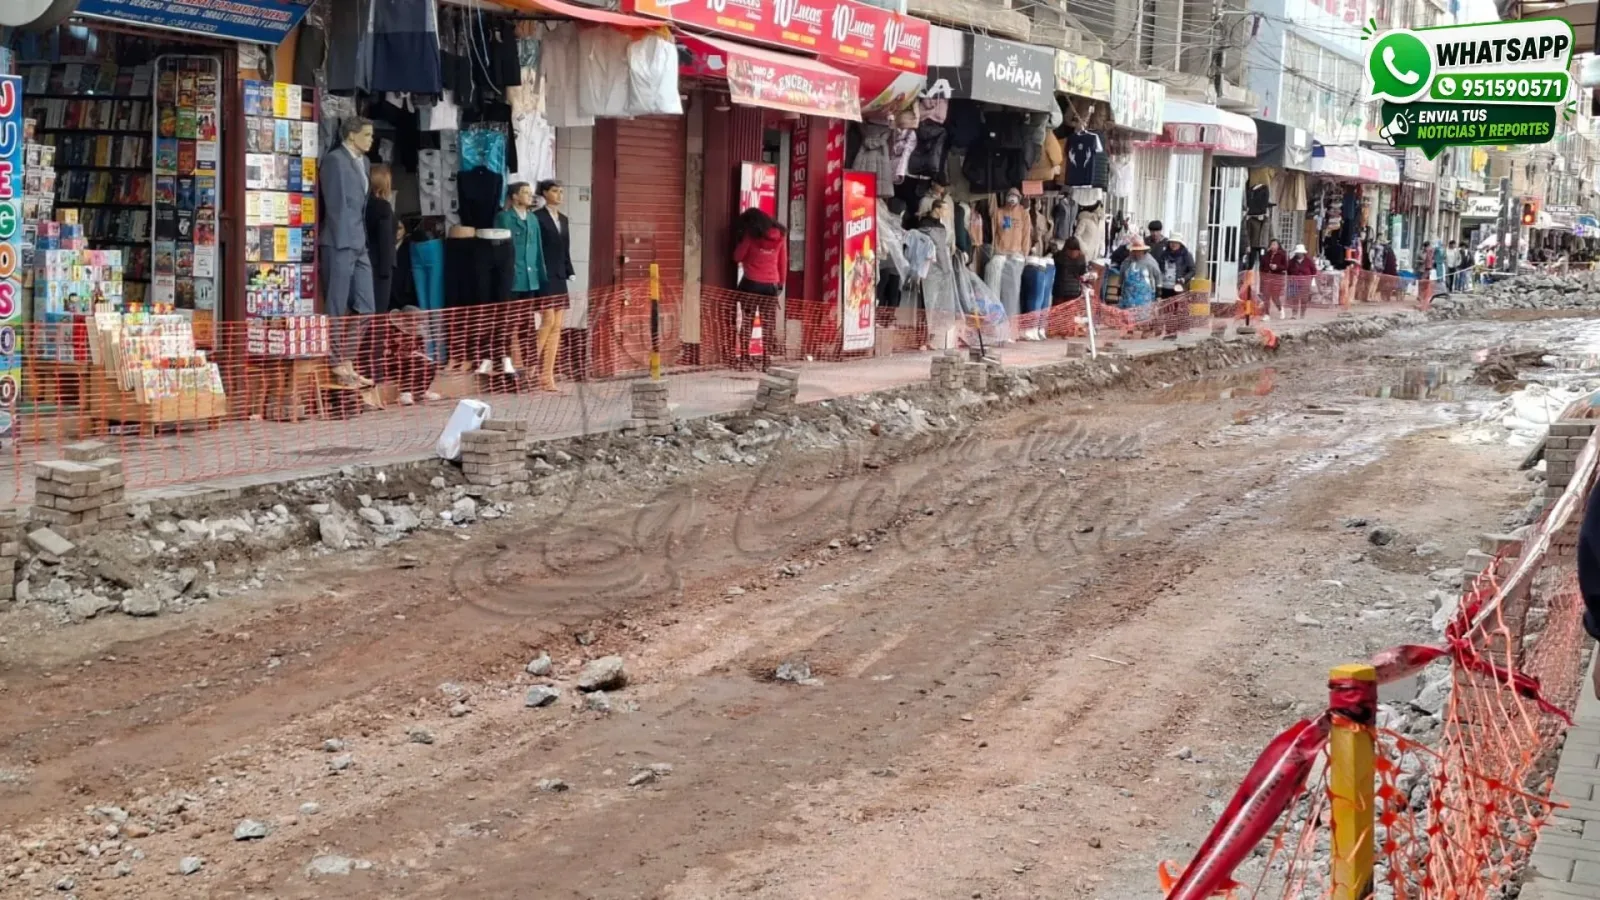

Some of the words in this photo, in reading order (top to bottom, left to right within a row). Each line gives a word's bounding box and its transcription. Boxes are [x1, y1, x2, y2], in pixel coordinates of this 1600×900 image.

[773, 0, 792, 27] 10
[791, 0, 823, 23] Lucas
[831, 3, 850, 42] 10
[848, 8, 877, 38] Lucas
[883, 17, 901, 54] 10
[898, 22, 923, 49] Lucas
[985, 60, 1042, 90] ADHARA
